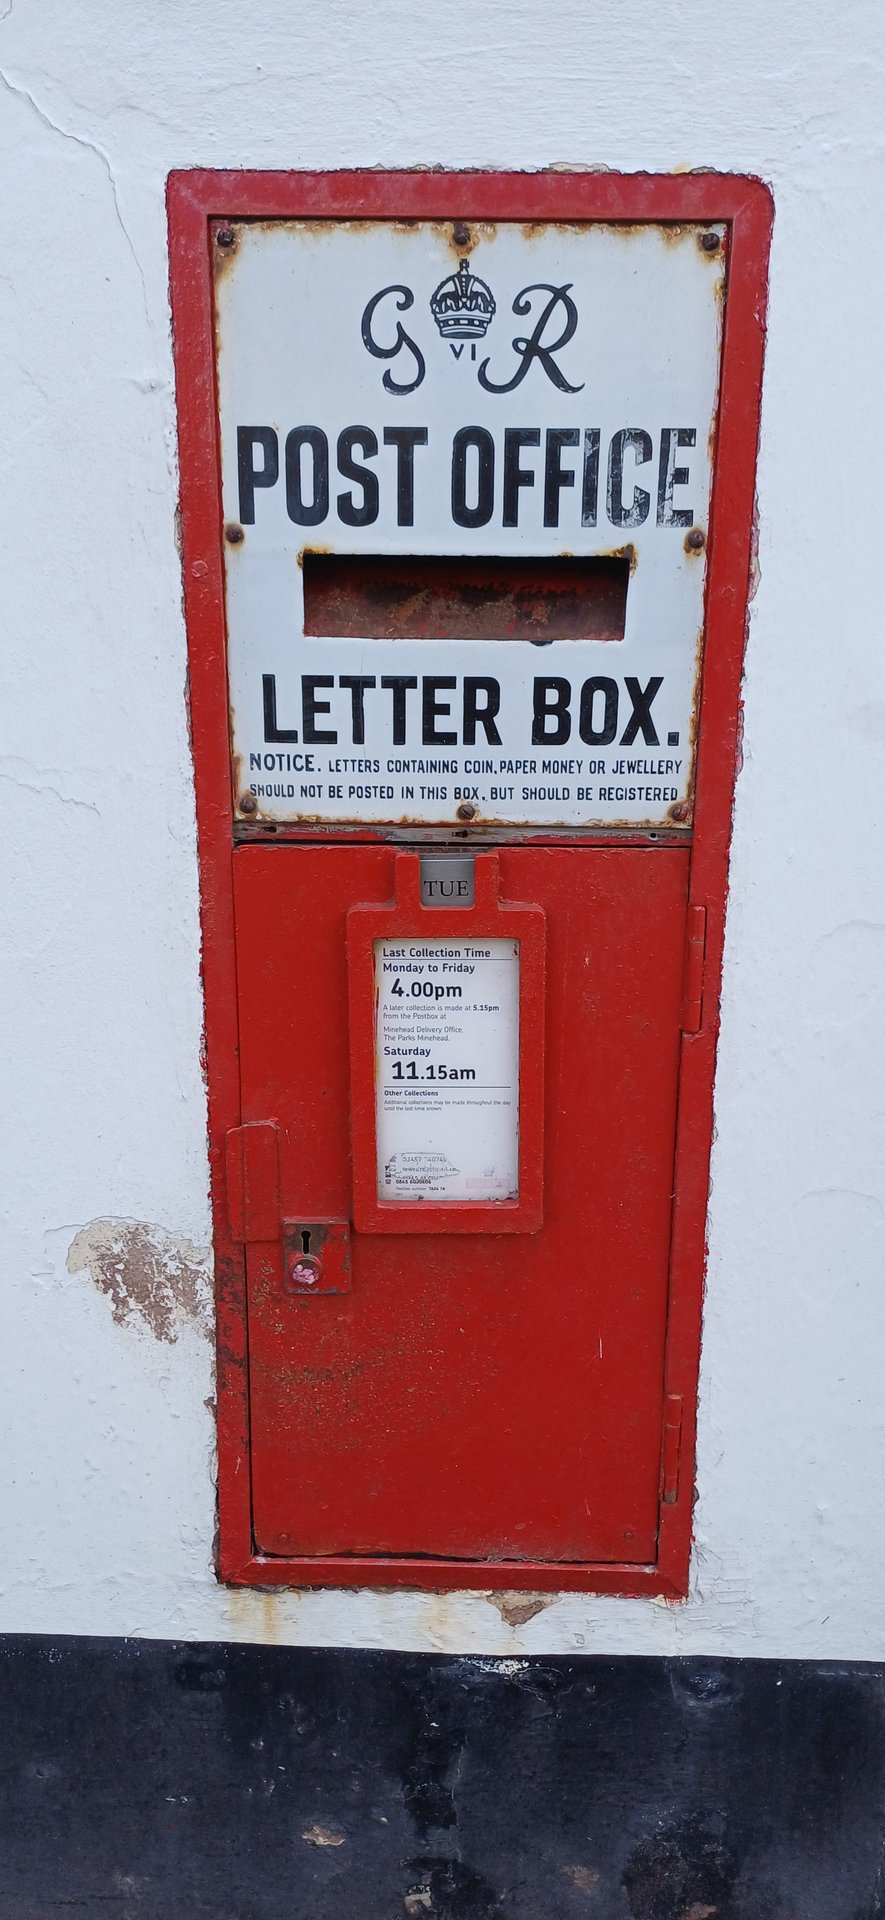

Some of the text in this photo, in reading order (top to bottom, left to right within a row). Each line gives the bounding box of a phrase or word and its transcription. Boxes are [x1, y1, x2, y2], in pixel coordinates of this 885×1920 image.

[361, 283, 585, 396] G R
[450, 343, 477, 361] VI
[237, 425, 697, 528] POST OFFICE
[262, 674, 679, 747] LETTER BOX.
[250, 753, 321, 772] NOTICE.
[328, 759, 380, 773] LETTERS
[387, 760, 458, 774] CONTAINING
[542, 760, 584, 774] MONEY
[589, 760, 605, 774] OR
[612, 760, 683, 775] JEWELLERY
[250, 784, 295, 798] SHOULD
[300, 784, 323, 798] NOT
[328, 785, 343, 799] BE
[348, 785, 394, 799] POSTED
[401, 786, 414, 799] IN
[420, 786, 447, 800] THIS
[490, 787, 514, 800] BUT
[522, 787, 570, 801] SHOULD
[577, 787, 593, 801] BE
[599, 787, 678, 801] REGISTERED
[423, 880, 469, 897] TUE
[383, 947, 491, 958] Last Collection Time
[383, 962, 475, 975] Monday to Friday
[391, 978, 462, 1001] 4.00pm
[473, 1005, 500, 1013] 5.15pm
[416, 1026, 442, 1034] Delivery
[384, 1046, 431, 1057] Saturday
[391, 1061, 476, 1080] 11.15am
